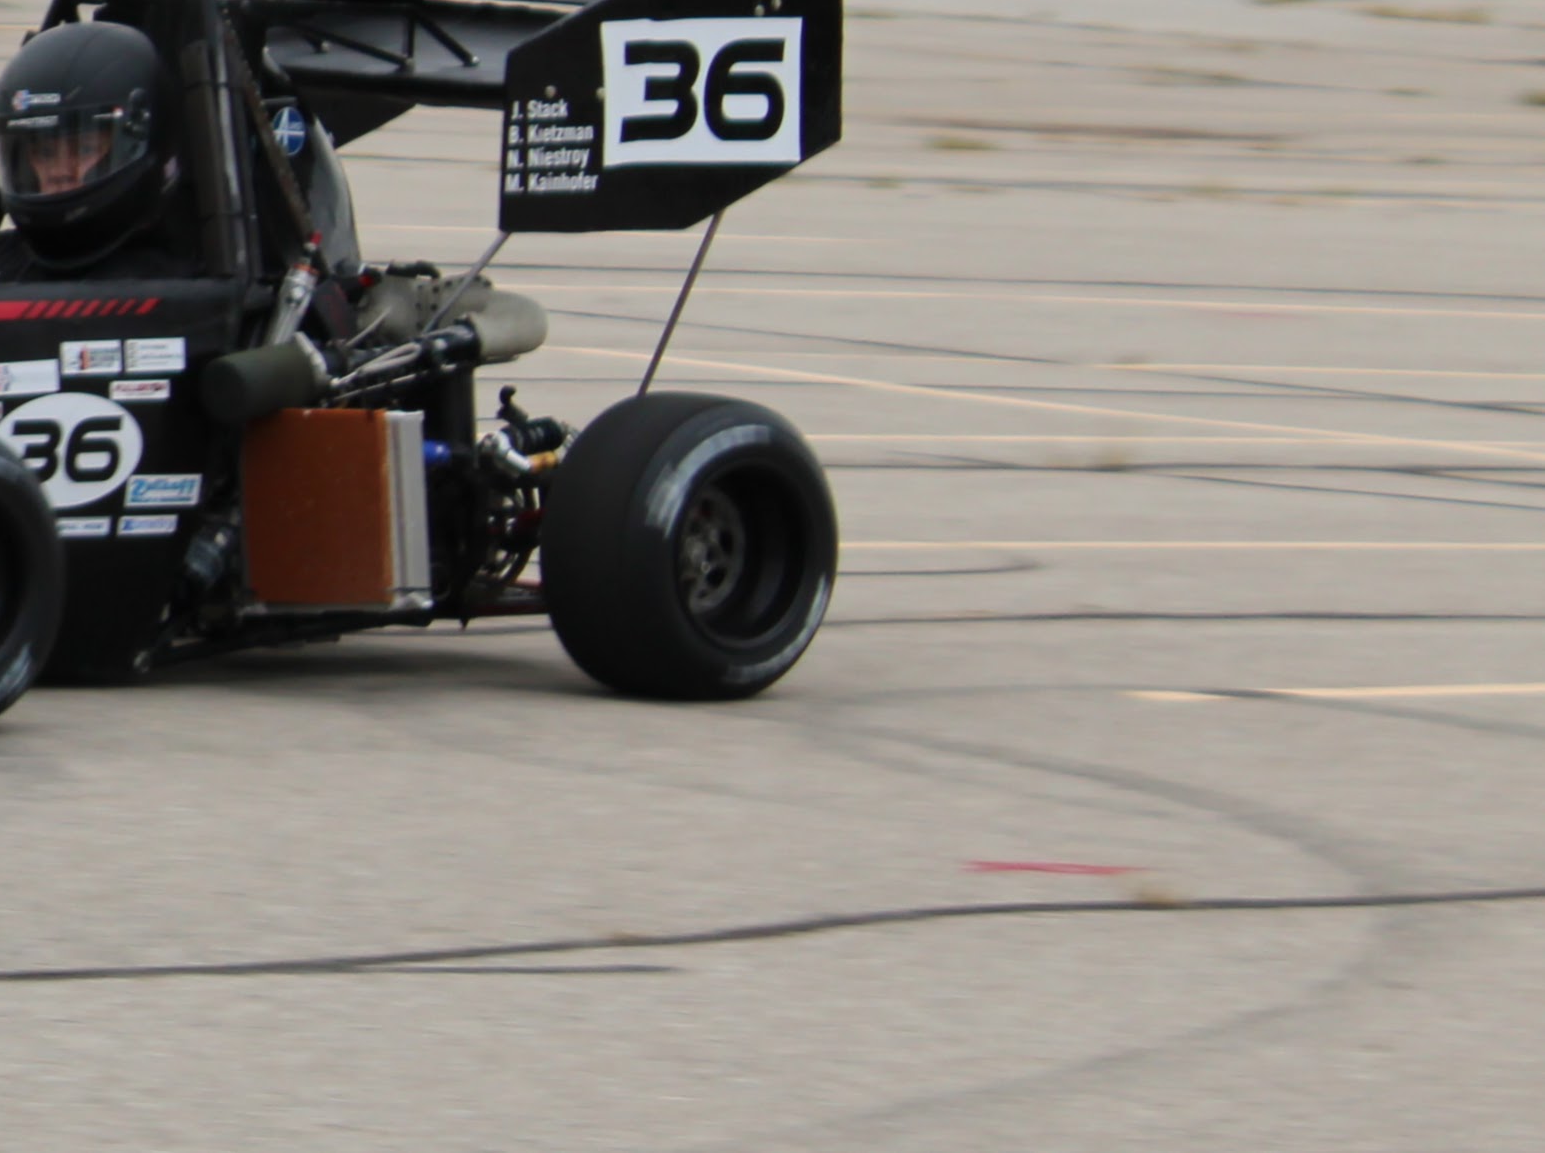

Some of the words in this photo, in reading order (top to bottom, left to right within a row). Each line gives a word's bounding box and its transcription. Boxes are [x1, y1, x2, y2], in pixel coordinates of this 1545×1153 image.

[619, 37, 787, 144] 36
[511, 100, 524, 120] J.
[527, 98, 569, 119] Stack
[508, 124, 524, 144] B.
[506, 148, 524, 169] N.
[527, 147, 591, 169] Niestroy
[504, 172, 524, 193] M.
[527, 171, 599, 193] Kainhofer
[11, 413, 125, 485] 36
